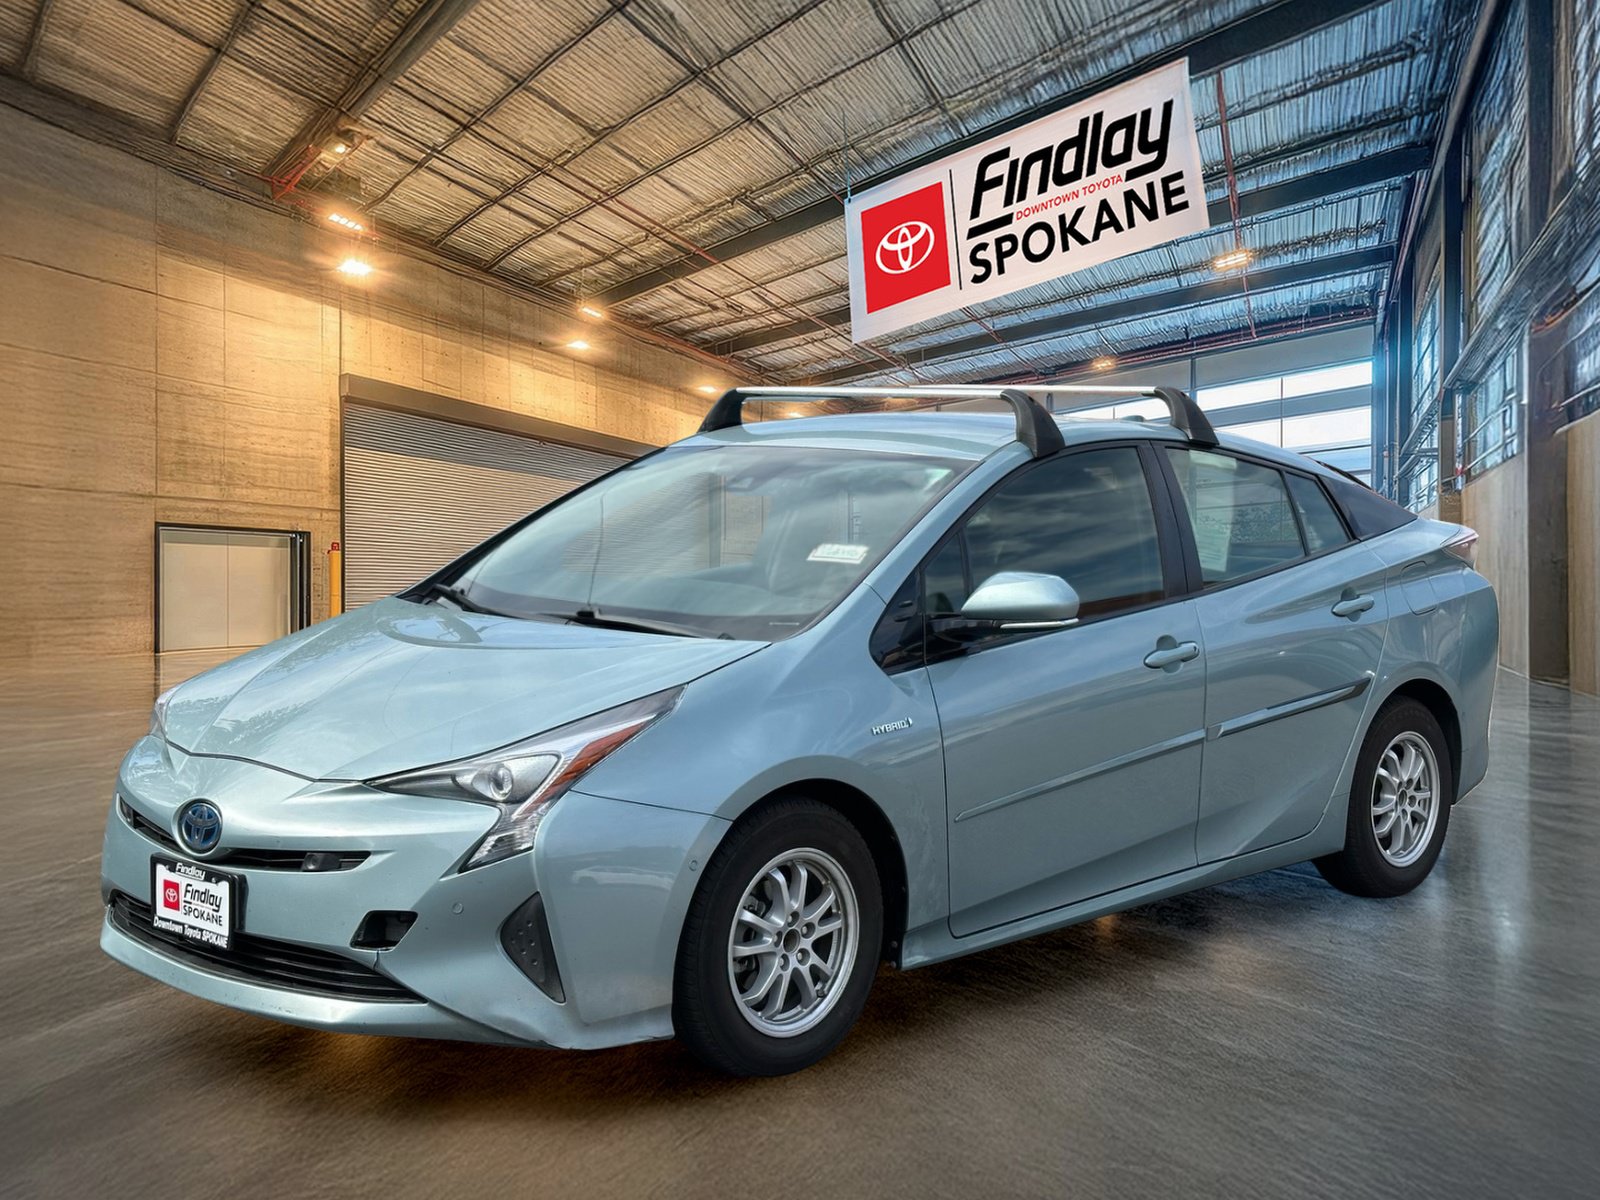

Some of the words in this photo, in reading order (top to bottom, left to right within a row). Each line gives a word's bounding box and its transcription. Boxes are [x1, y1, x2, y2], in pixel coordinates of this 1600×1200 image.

[970, 98, 1174, 221] Findlay
[1016, 190, 1080, 221] DOWNTOWN
[1082, 174, 1123, 197] TOYOTA
[969, 171, 1190, 284] SPOKANE
[872, 719, 908, 735] HYBRID
[175, 862, 206, 880] Findlay
[183, 883, 222, 912] Findlay
[183, 905, 223, 926] SPOKANE
[153, 916, 183, 934] Downtown
[184, 924, 201, 940] Toyota
[202, 929, 228, 948] SPOKANE
